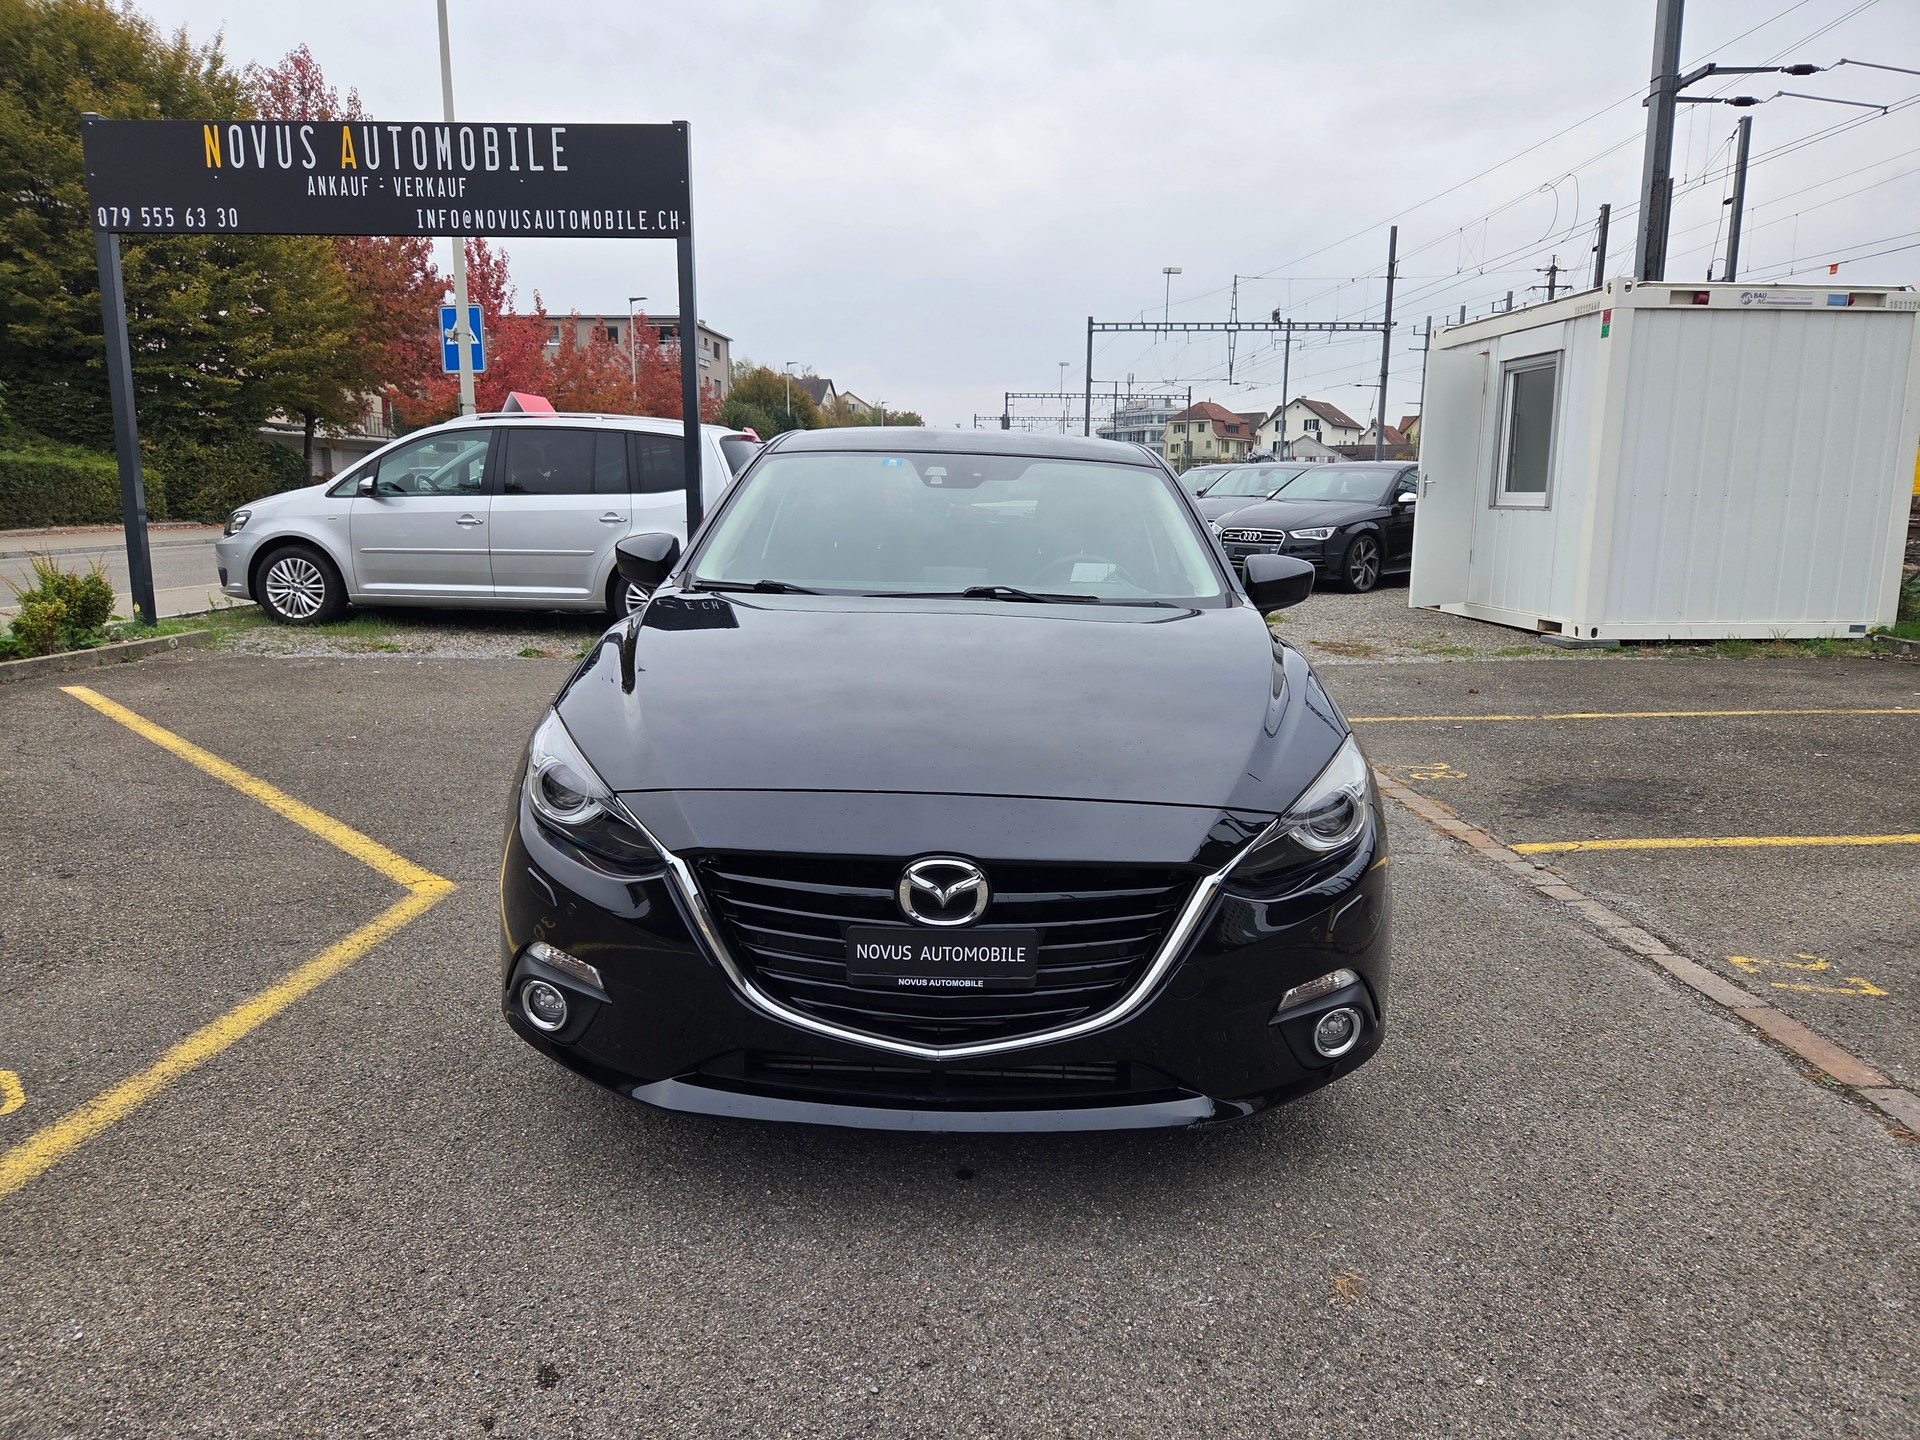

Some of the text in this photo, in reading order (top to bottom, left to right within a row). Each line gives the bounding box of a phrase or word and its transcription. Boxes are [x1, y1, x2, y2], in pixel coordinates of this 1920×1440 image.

[203, 124, 568, 172] NOVUS AUTOMOBILE
[307, 175, 369, 196] ANKAUF
[393, 177, 467, 198] VERKAUF
[97, 207, 239, 227] 079 555 63 30
[416, 209, 680, 230] INFO@NOVUSAUTOMOBILE.CH
[856, 944, 1026, 963] NOVUS AUTOMOBILE
[898, 978, 984, 988] NOVUS AUTOMOBILE
